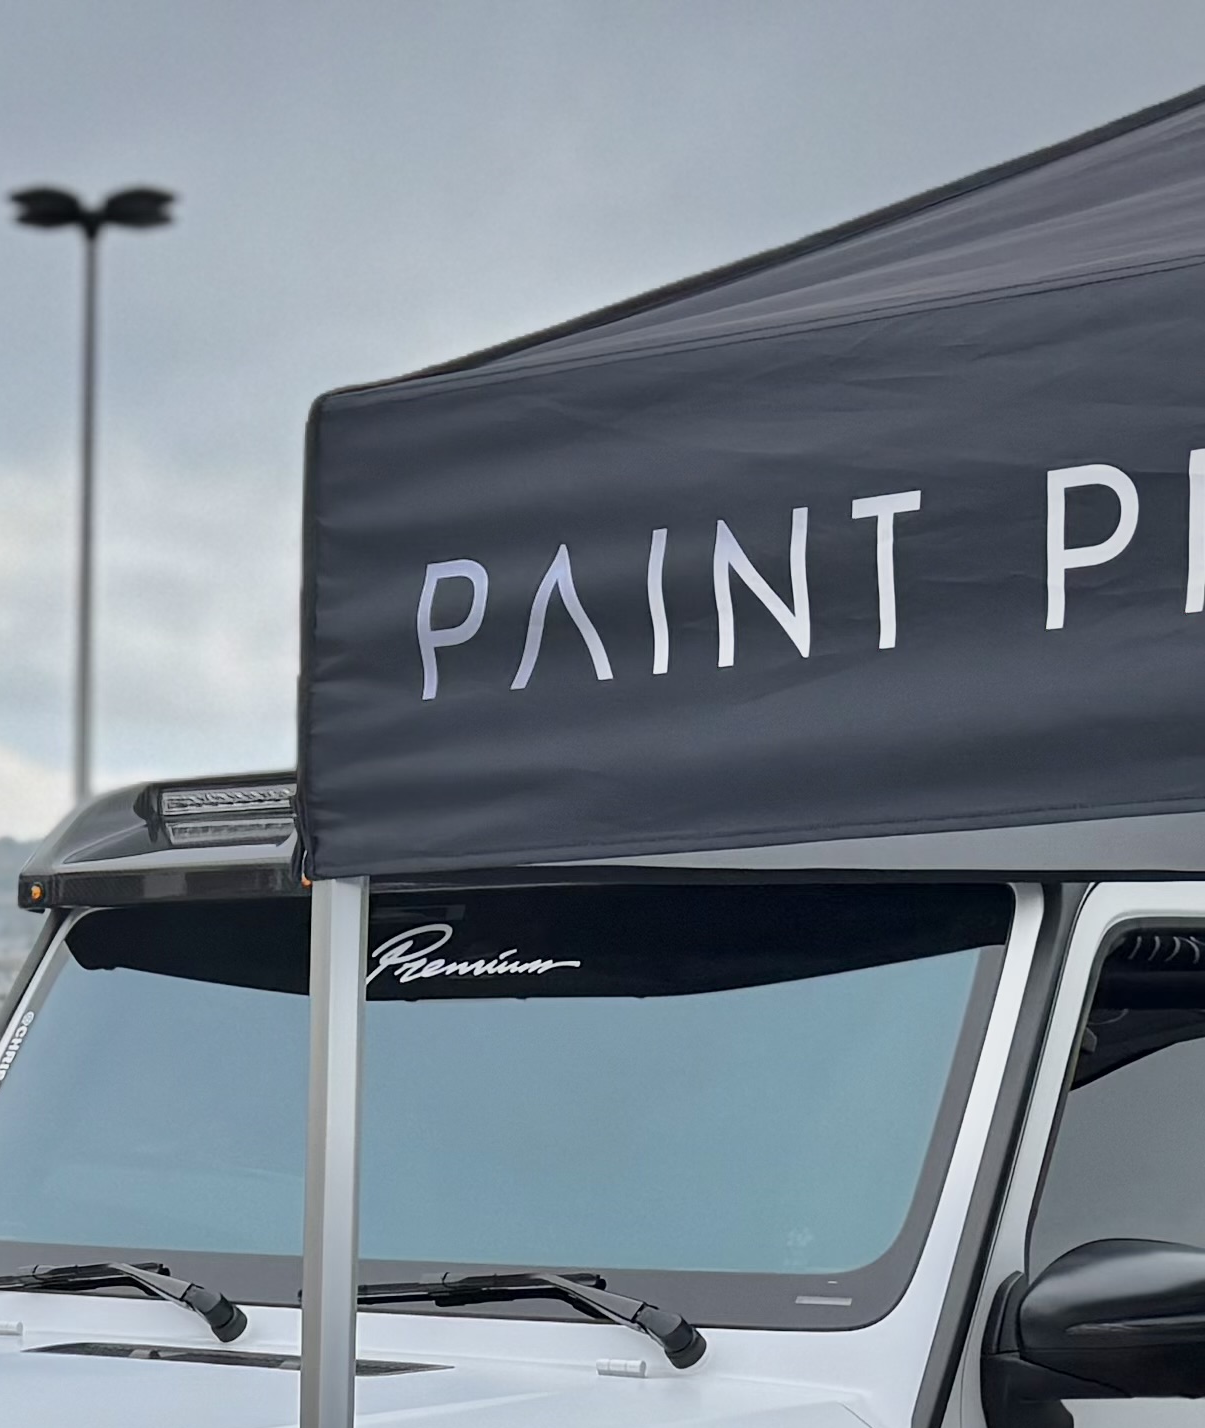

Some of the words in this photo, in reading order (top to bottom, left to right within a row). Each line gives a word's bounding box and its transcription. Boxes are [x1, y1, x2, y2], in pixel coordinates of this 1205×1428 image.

[416, 490, 922, 701] PAINT
[1046, 447, 1205, 630] P
[365, 923, 581, 983] Premium
